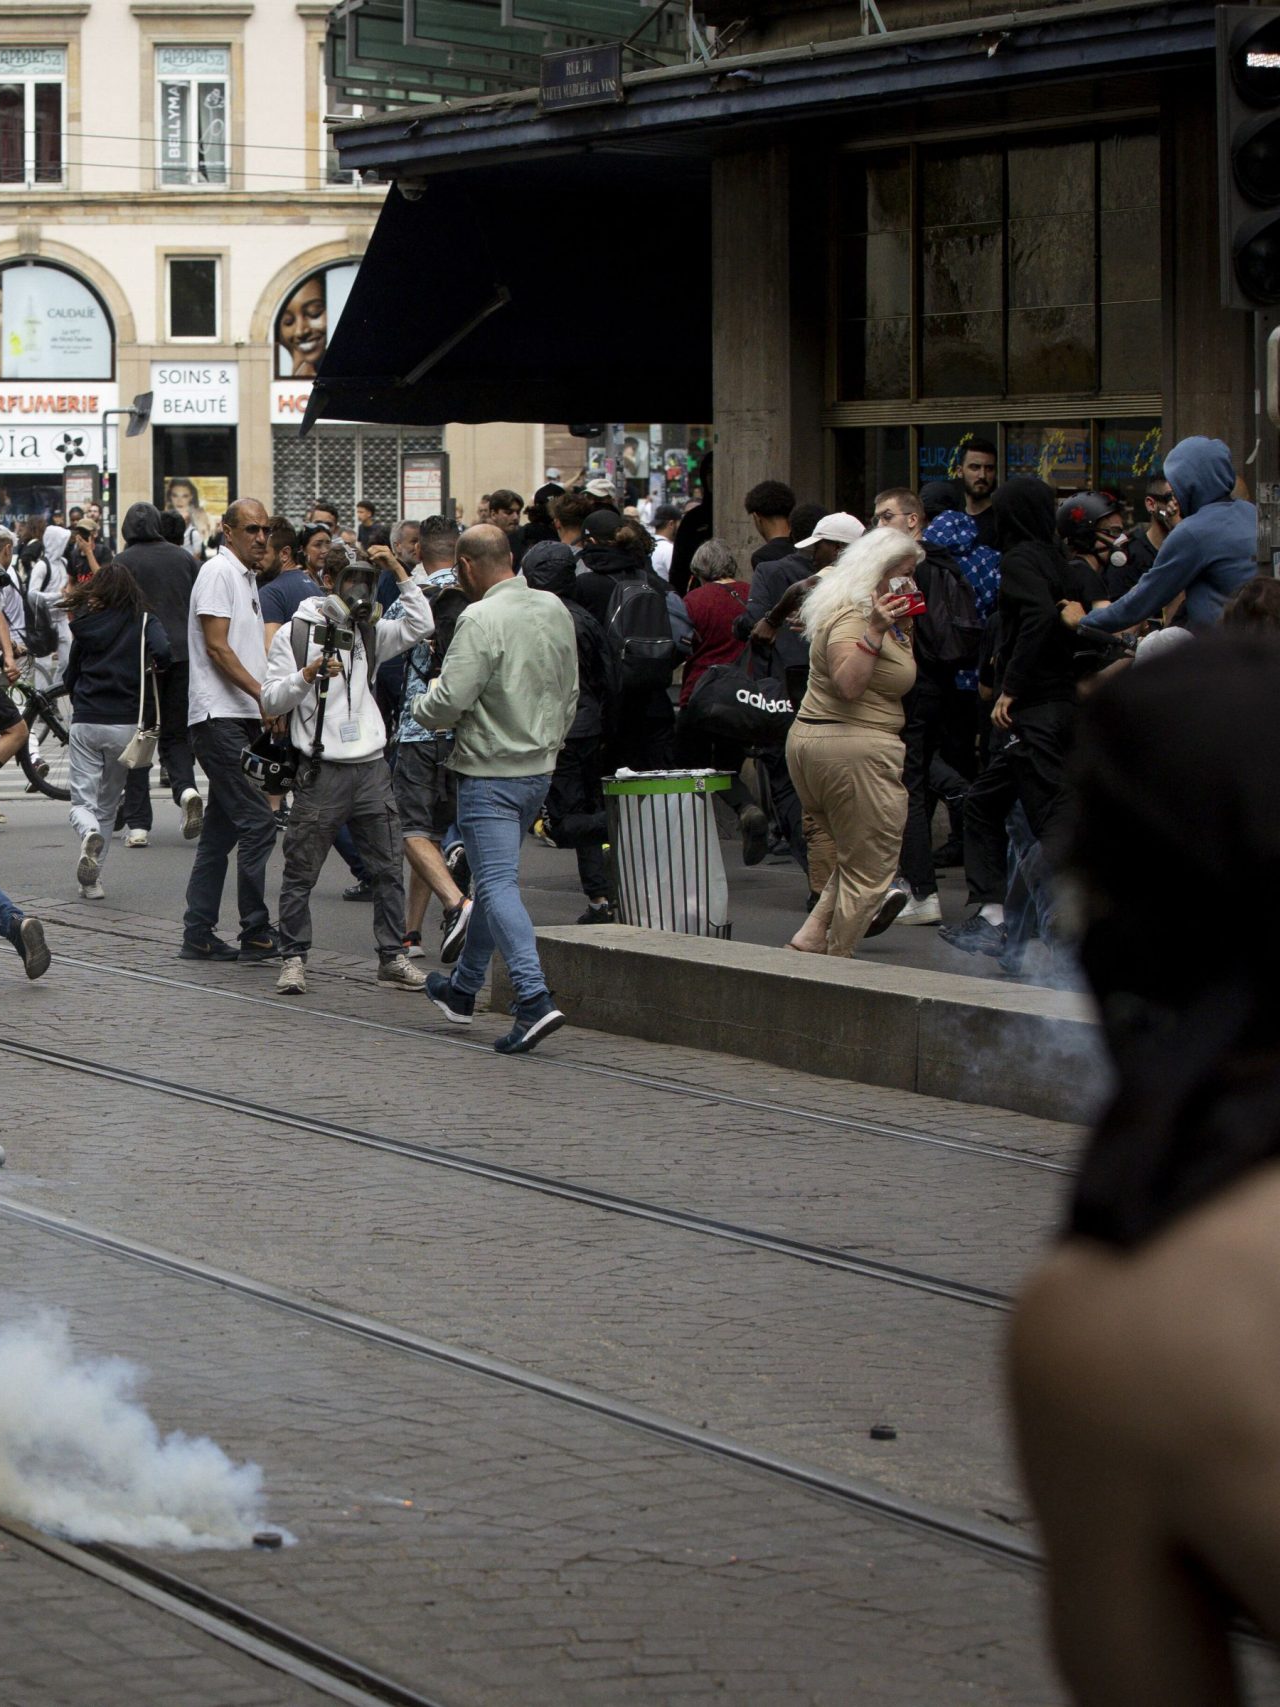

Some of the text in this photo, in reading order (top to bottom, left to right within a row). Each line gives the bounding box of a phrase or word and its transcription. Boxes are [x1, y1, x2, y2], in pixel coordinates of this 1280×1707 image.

[566, 58, 593, 76] RUE DU
[542, 86, 562, 101] VIEUX
[600, 78, 617, 92] VINS
[168, 80, 181, 159] BELLYMA
[158, 370, 231, 384] SOINS &
[163, 396, 227, 413] BEAUTÉ
[736, 689, 794, 713] adidas
